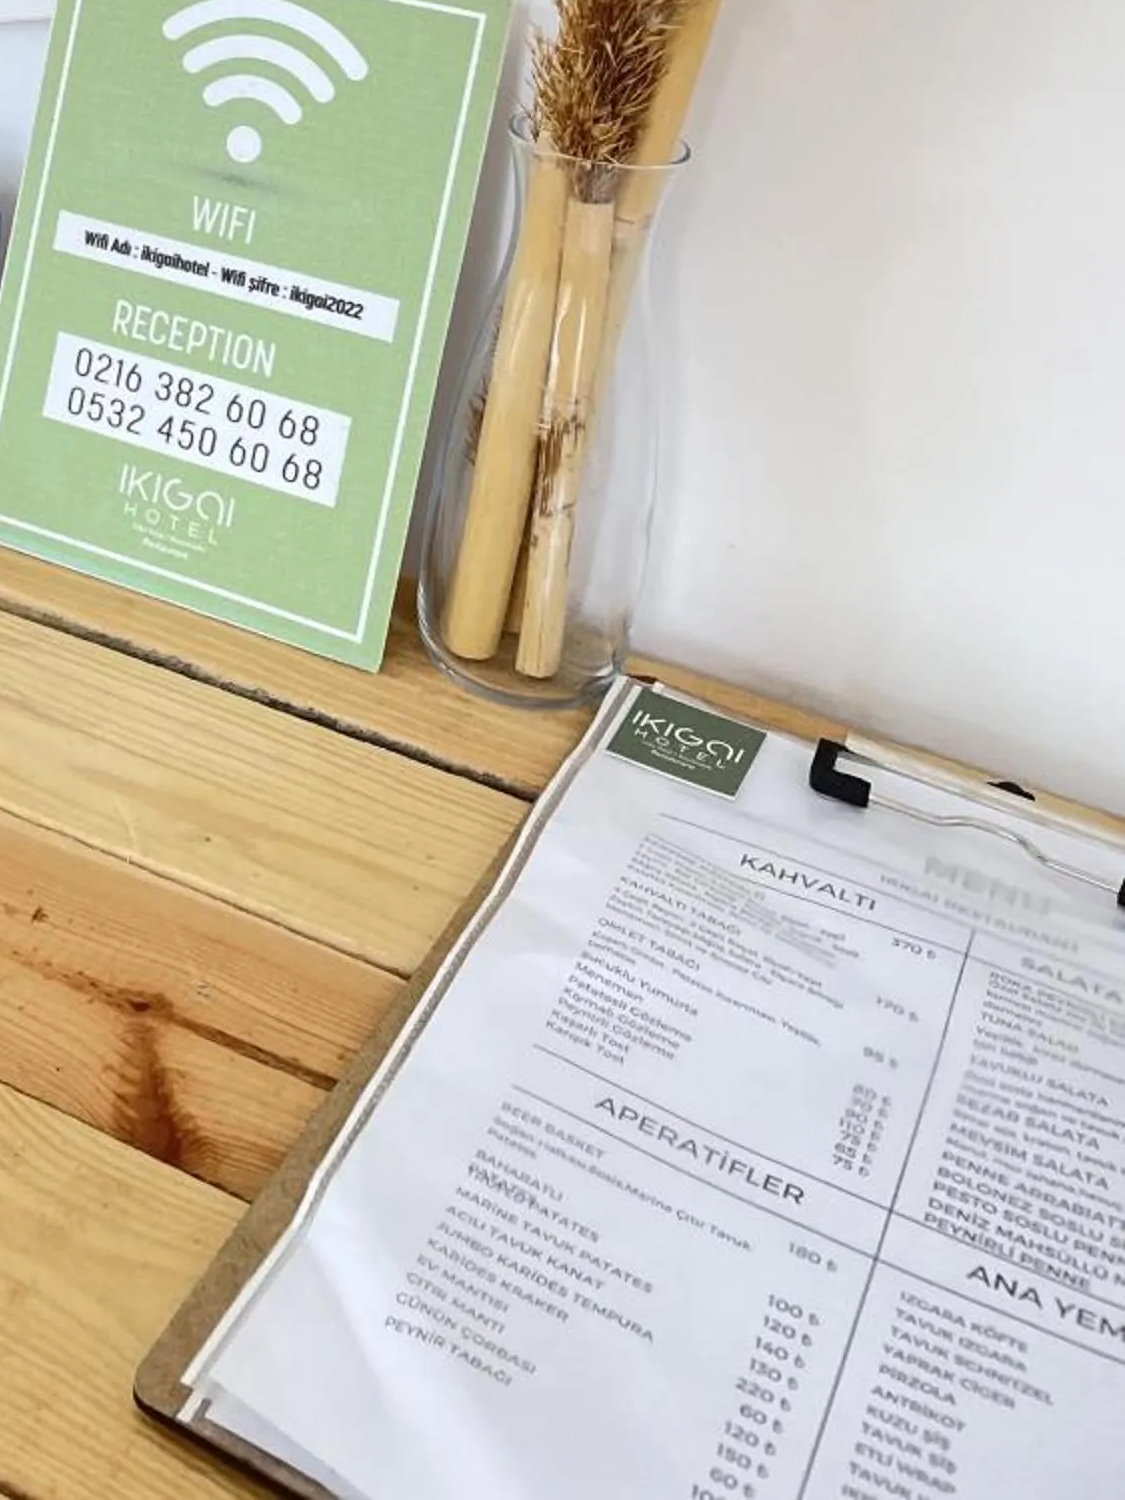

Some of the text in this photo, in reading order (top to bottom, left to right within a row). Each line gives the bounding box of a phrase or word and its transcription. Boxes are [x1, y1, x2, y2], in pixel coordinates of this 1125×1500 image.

[192, 196, 256, 245] WIFI
[84, 229, 109, 250] Wifi
[110, 237, 133, 257] Adı
[140, 245, 211, 278] ikigaihotel
[220, 267, 246, 287] Wifi
[248, 274, 281, 298] şifre
[289, 284, 365, 321] ikigai2022
[112, 299, 275, 378] RECEPTION
[75, 347, 320, 446] 0216 382 60 68
[68, 386, 323, 490] 0532 450 60 68
[123, 503, 219, 545] HOTEL
[632, 710, 745, 763] IKIGAI
[635, 728, 725, 770] HOTEL
[738, 852, 877, 912] KAHVALTI
[1045, 1076, 1109, 1108] SALATA
[593, 1093, 806, 1207] APERATİFLER
[1023, 1115, 1101, 1151] SALATA
[940, 1148, 1011, 1187] PENNE
[1031, 1151, 1110, 1191] SALATA
[932, 1178, 999, 1217] PESTO
[1001, 1207, 1069, 1246] SOSLU
[936, 1164, 1034, 1215] BOLONEZ
[1037, 1206, 1104, 1244] SOSLU
[488, 1223, 544, 1262] TAVUK
[545, 1252, 605, 1293] KANAT
[520, 1218, 576, 1256] TAVUK
[577, 1247, 655, 1296] PATATES
[1019, 1251, 1090, 1292] PENNE
[498, 1276, 571, 1325] KRAKER
[966, 1259, 1045, 1310] ANA
[449, 1295, 507, 1336] MANTI
[571, 1290, 656, 1344] TEMPURA
[761, 1312, 798, 1342] 120
[765, 1291, 804, 1322] 100
[894, 1306, 954, 1343] TAVUK
[753, 1333, 791, 1364] 140
[889, 1324, 950, 1360] TAVUK
[733, 1372, 776, 1407] 220
[721, 1416, 761, 1451] 120
[737, 1400, 769, 1429] 60
[865, 1401, 919, 1437] KUZU
[859, 1420, 923, 1459] TAVUK
